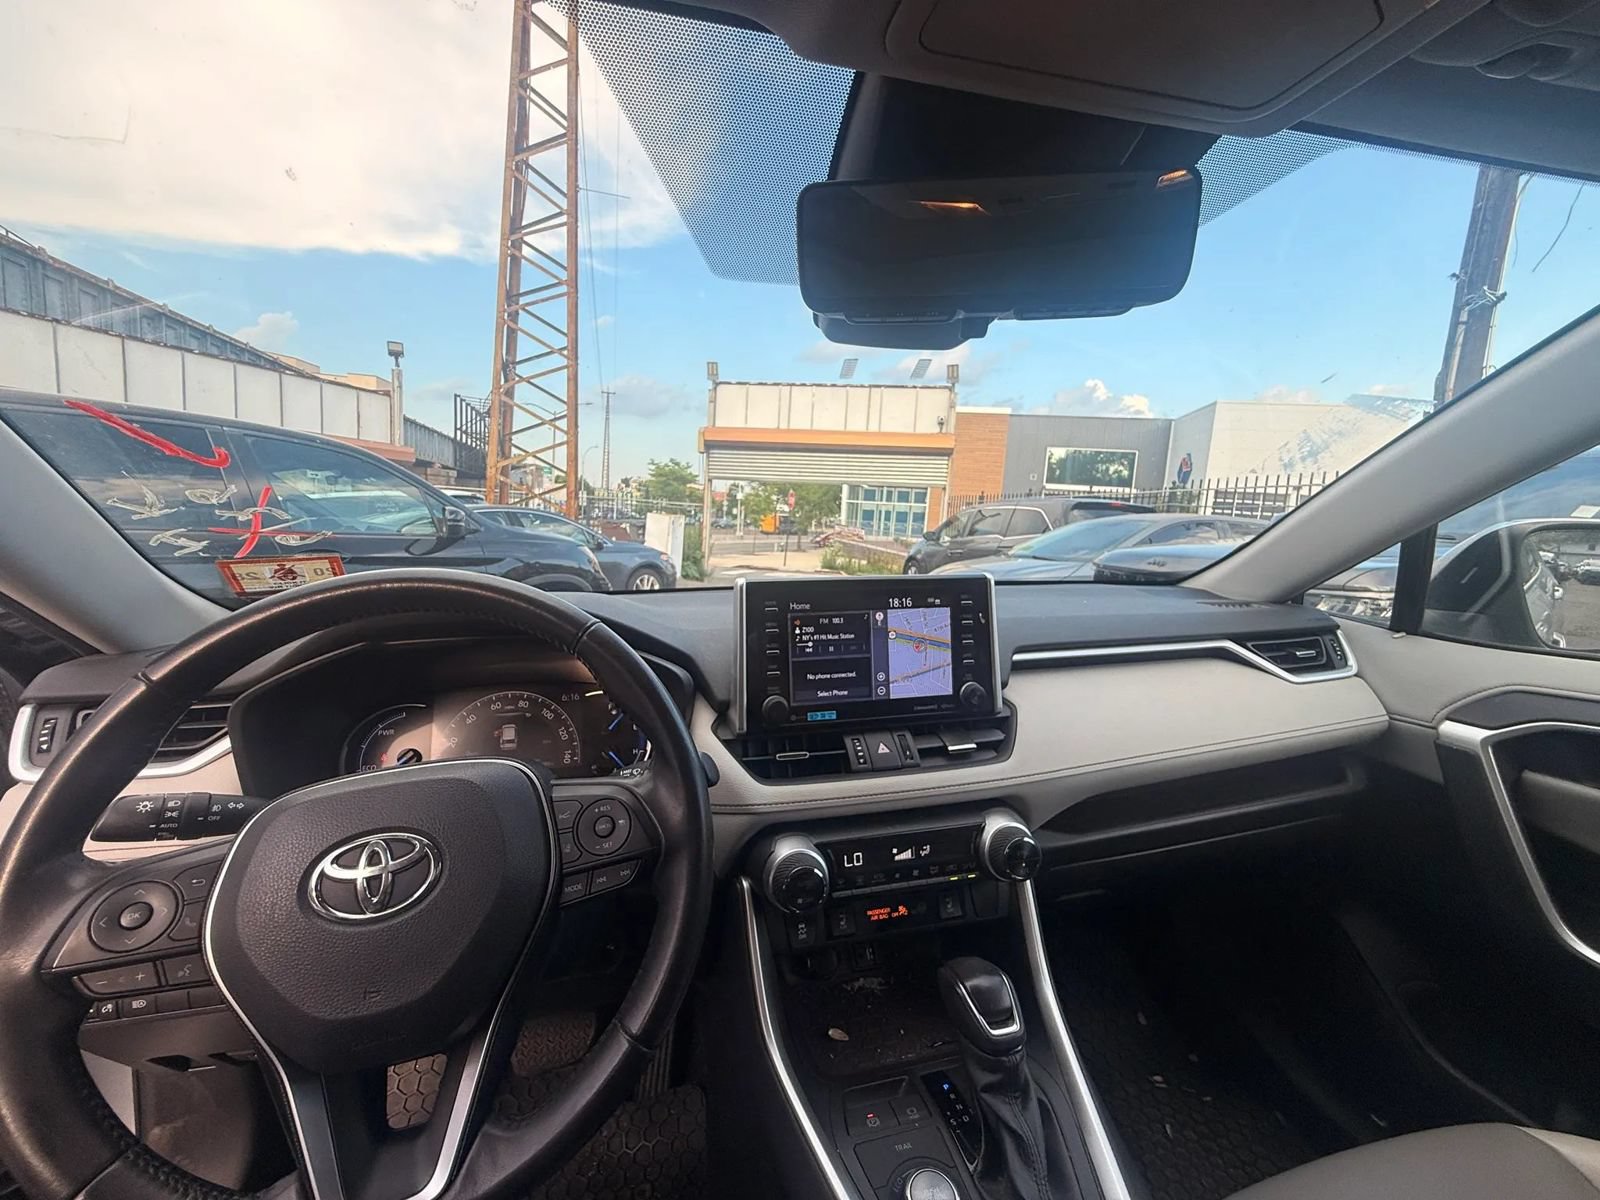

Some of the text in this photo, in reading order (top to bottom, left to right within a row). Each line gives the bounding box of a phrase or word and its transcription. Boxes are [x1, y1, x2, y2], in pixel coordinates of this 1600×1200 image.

[789, 602, 811, 610] Home
[888, 597, 912, 608] 18:16
[561, 693, 580, 702] 6:16
[490, 701, 502, 711] 60
[518, 700, 529, 708] 80
[541, 708, 554, 720] 100
[465, 714, 477, 725] 40
[377, 728, 395, 736] PWR
[558, 726, 568, 741] 120
[448, 736, 458, 748] 20
[563, 749, 572, 764] 140
[362, 764, 377, 772] ECO
[843, 852, 863, 868] LO
[564, 883, 583, 892] MODE
[127, 911, 142, 920] OK
